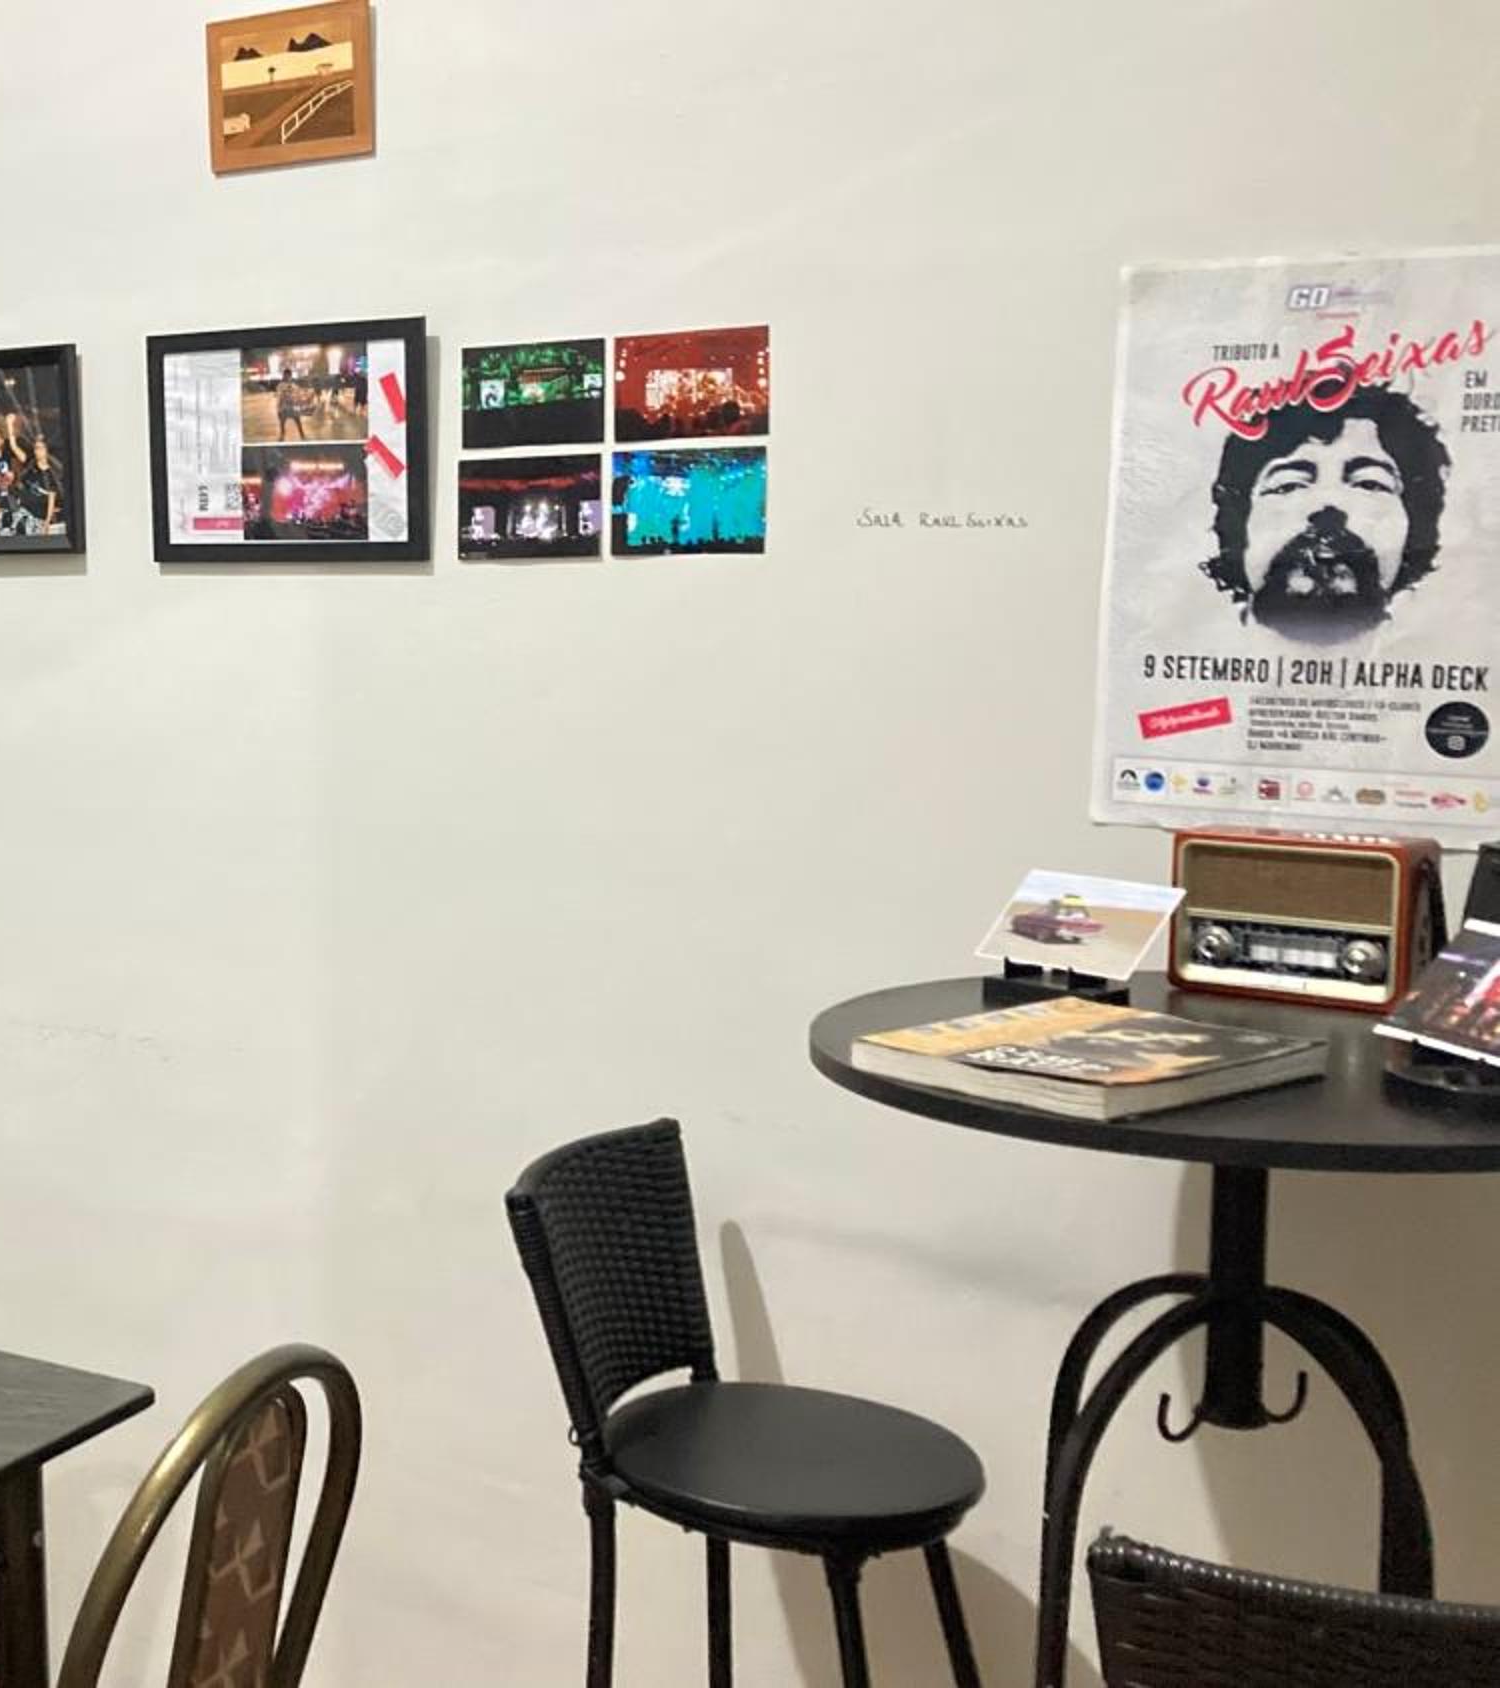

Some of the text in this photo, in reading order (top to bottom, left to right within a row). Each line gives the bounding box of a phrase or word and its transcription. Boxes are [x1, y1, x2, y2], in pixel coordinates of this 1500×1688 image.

[1212, 342, 1280, 362] TRIBUTO A
[1464, 369, 1488, 388] EM
[1461, 415, 1500, 432] PRET
[1143, 654, 1490, 692] 9 SETEMBRO 20H ALPHA DECK
